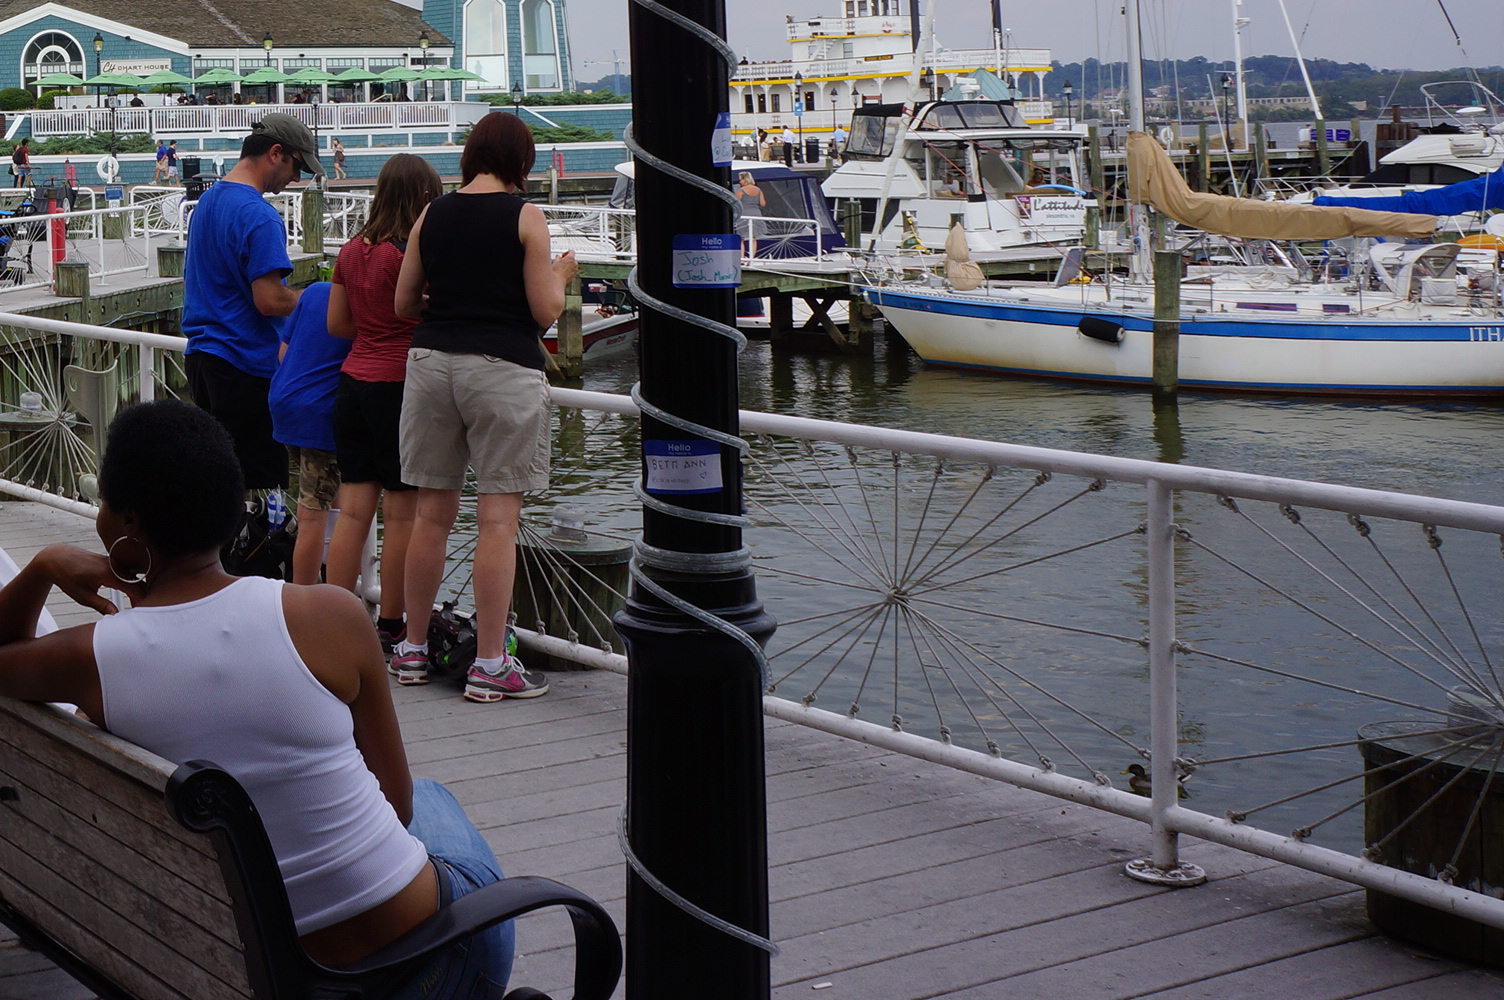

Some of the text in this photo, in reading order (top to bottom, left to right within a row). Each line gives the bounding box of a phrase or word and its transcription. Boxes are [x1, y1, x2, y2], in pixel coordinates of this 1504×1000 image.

[1033, 198, 1085, 211] L'attitude
[701, 237, 723, 245] Hello
[677, 251, 714, 267] Josh
[1469, 327, 1504, 342] ITH
[667, 443, 691, 452] Hello
[683, 459, 706, 469] ANN
